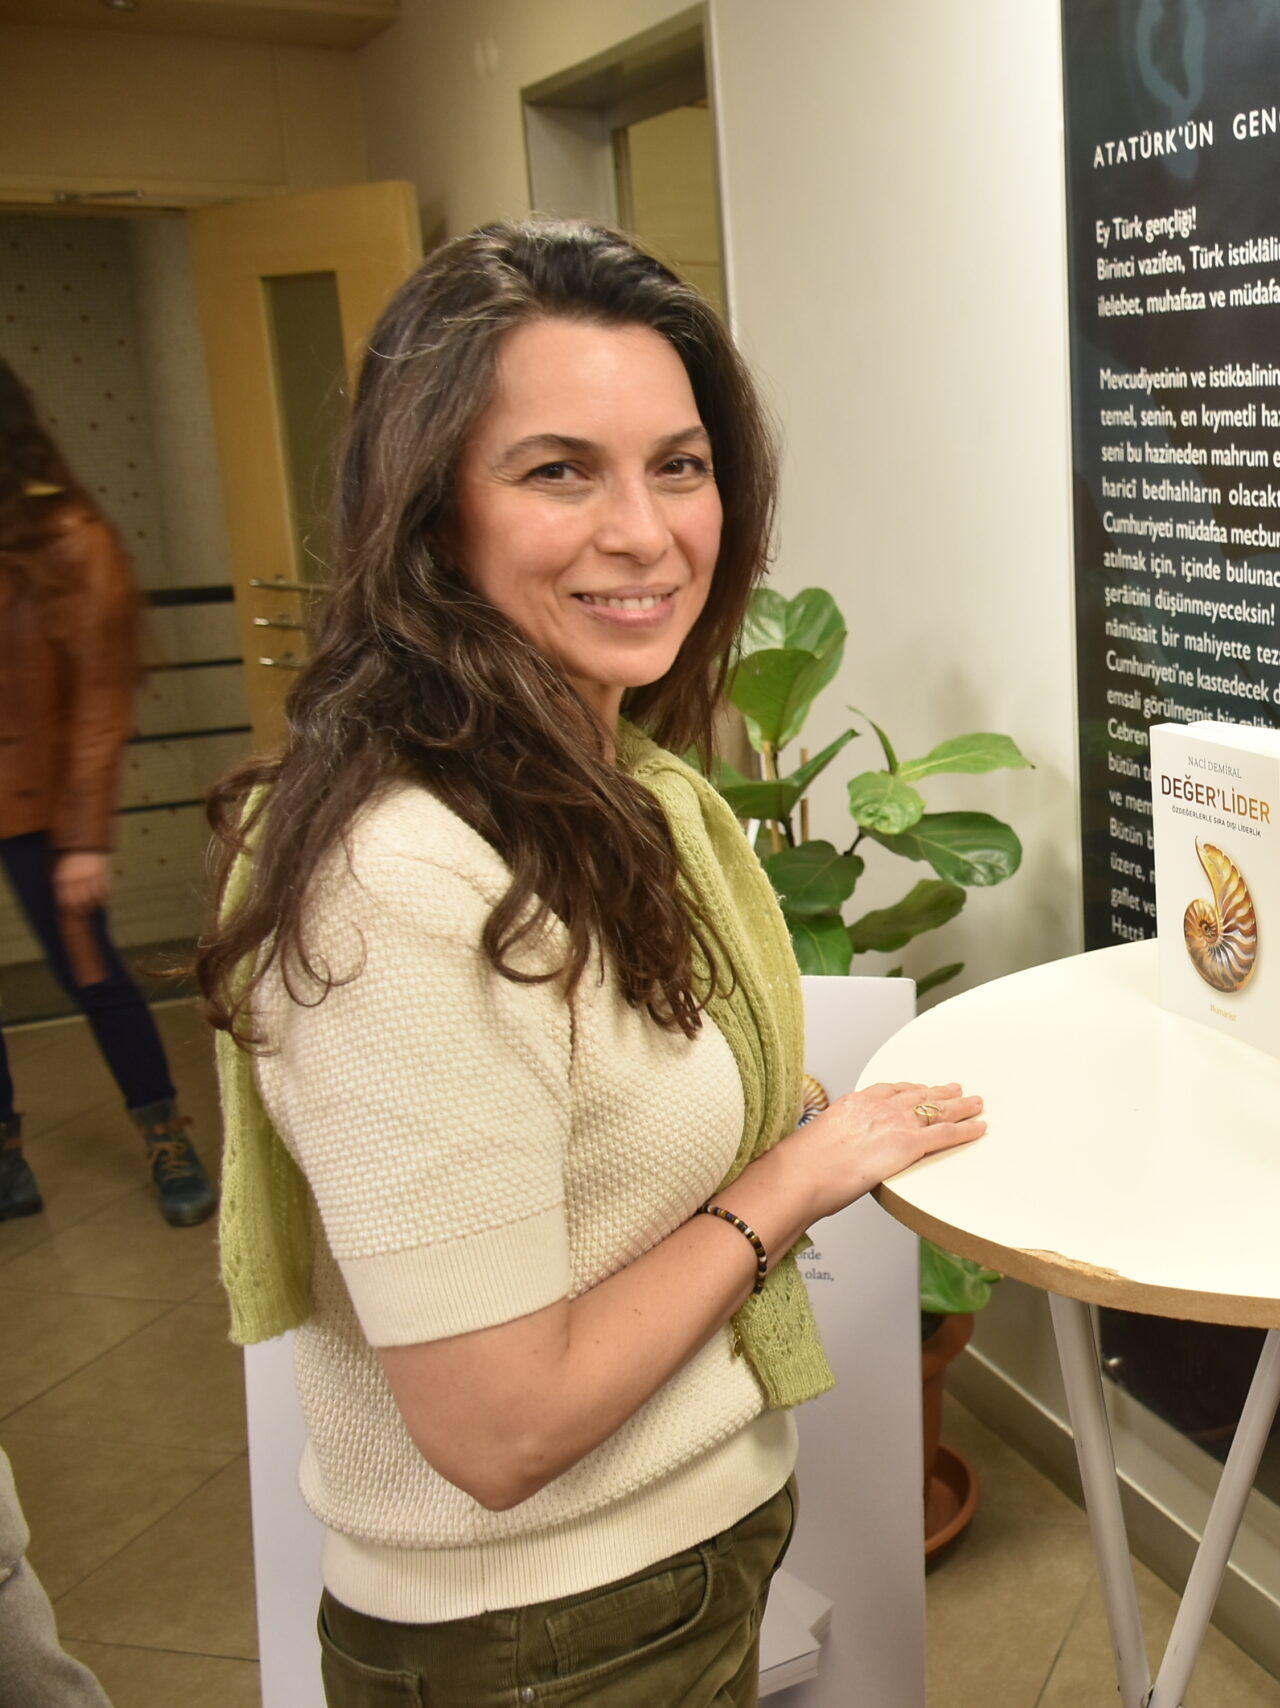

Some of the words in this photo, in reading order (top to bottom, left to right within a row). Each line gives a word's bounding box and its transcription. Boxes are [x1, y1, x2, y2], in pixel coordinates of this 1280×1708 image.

[1094, 120, 1214, 168] ATATÜRK'ÜN
[1096, 220, 1109, 248] Ey
[1114, 217, 1142, 240] Türk
[1145, 207, 1196, 243] gençliği!
[1097, 255, 1135, 280] Birinci
[1139, 250, 1185, 274] vazifen,
[1190, 245, 1224, 270] Türk
[1098, 295, 1143, 318] ilelebet,
[1147, 289, 1205, 314] muhafaza
[1210, 289, 1225, 308] ve
[1100, 367, 1188, 395] Mevcudiyetinin
[1191, 371, 1205, 388] ve
[1209, 363, 1280, 387] istikbalinin
[1101, 404, 1137, 428] temel,
[1141, 406, 1177, 428] senin,
[1181, 410, 1197, 426] en
[1202, 404, 1256, 433] kıymetli
[1102, 441, 1124, 462] seni
[1127, 442, 1142, 462] bu
[1145, 442, 1207, 465] hazineden
[1211, 444, 1268, 469] mahrum
[1102, 477, 1137, 499] haricî
[1142, 478, 1221, 505] bedhahların
[1103, 510, 1174, 541] Cumhuriyeti
[1176, 518, 1227, 544] müdafaa
[1103, 550, 1146, 572] atılmak
[1151, 553, 1176, 579] için,
[1181, 557, 1220, 583] içinde
[1155, 588, 1275, 626] düşünmeyeceksin!
[1105, 619, 1157, 644] nâmüsait
[1161, 624, 1180, 647] bir
[1184, 630, 1251, 661] mahiyette
[1107, 686, 1141, 712] emsali
[1197, 669, 1269, 702] kastedecek
[1107, 718, 1148, 749] Cebren
[1108, 751, 1140, 779] bütün
[1188, 756, 1206, 769] NACİ
[1208, 761, 1242, 778] DEMİRAL
[1108, 791, 1122, 808] ve
[1161, 774, 1270, 824] DEĞER'LİDER
[1110, 818, 1143, 847] Bütün
[1172, 805, 1212, 823] ÖZDEĞERLERLE
[1214, 818, 1225, 826] SIRA
[1226, 821, 1237, 830] DIŞI
[1238, 824, 1261, 837] LİDERLİK
[1110, 852, 1145, 881] üzere,
[1111, 884, 1138, 912] gaflet
[805, 1267, 834, 1282] olan,
